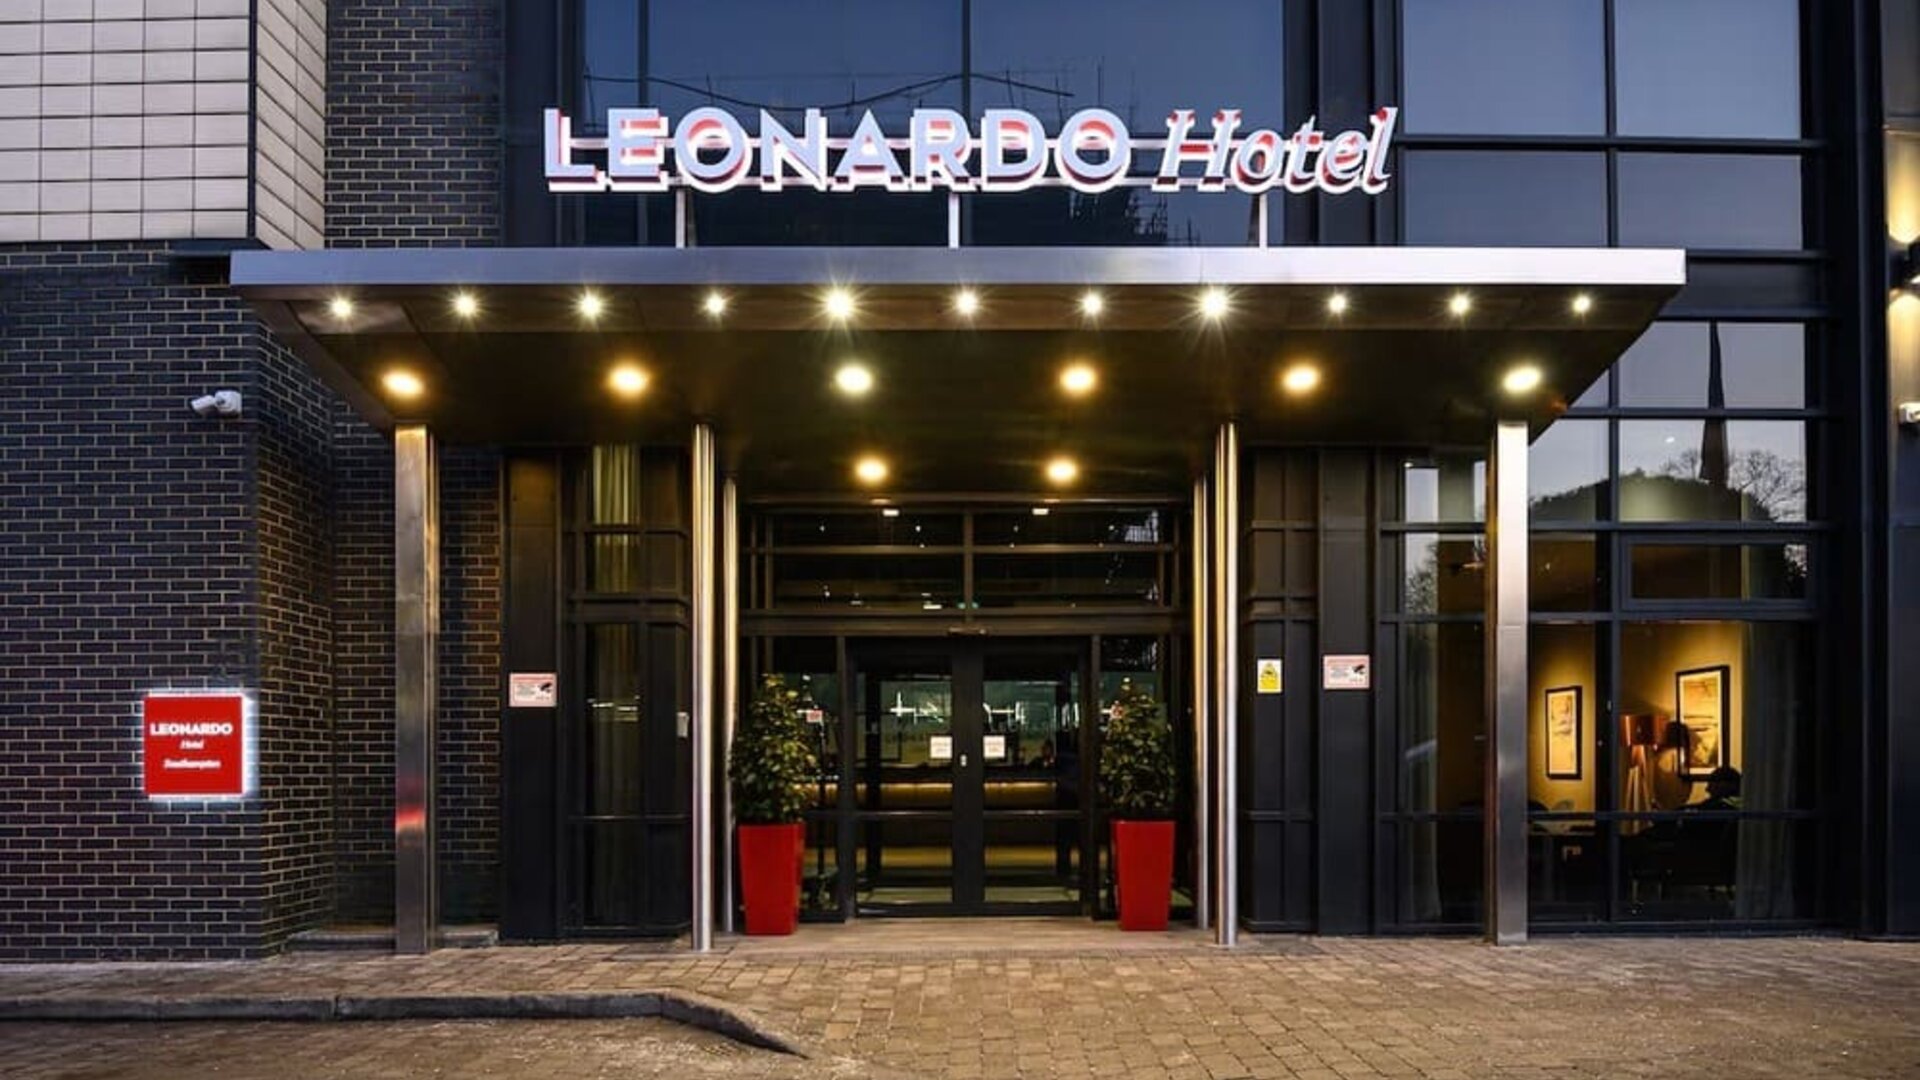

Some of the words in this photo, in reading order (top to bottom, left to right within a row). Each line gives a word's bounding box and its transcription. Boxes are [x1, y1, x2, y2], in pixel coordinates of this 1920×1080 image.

[544, 106, 1131, 193] LEONARDO
[1151, 106, 1398, 194] Hotel
[149, 723, 233, 735] LEONARDO
